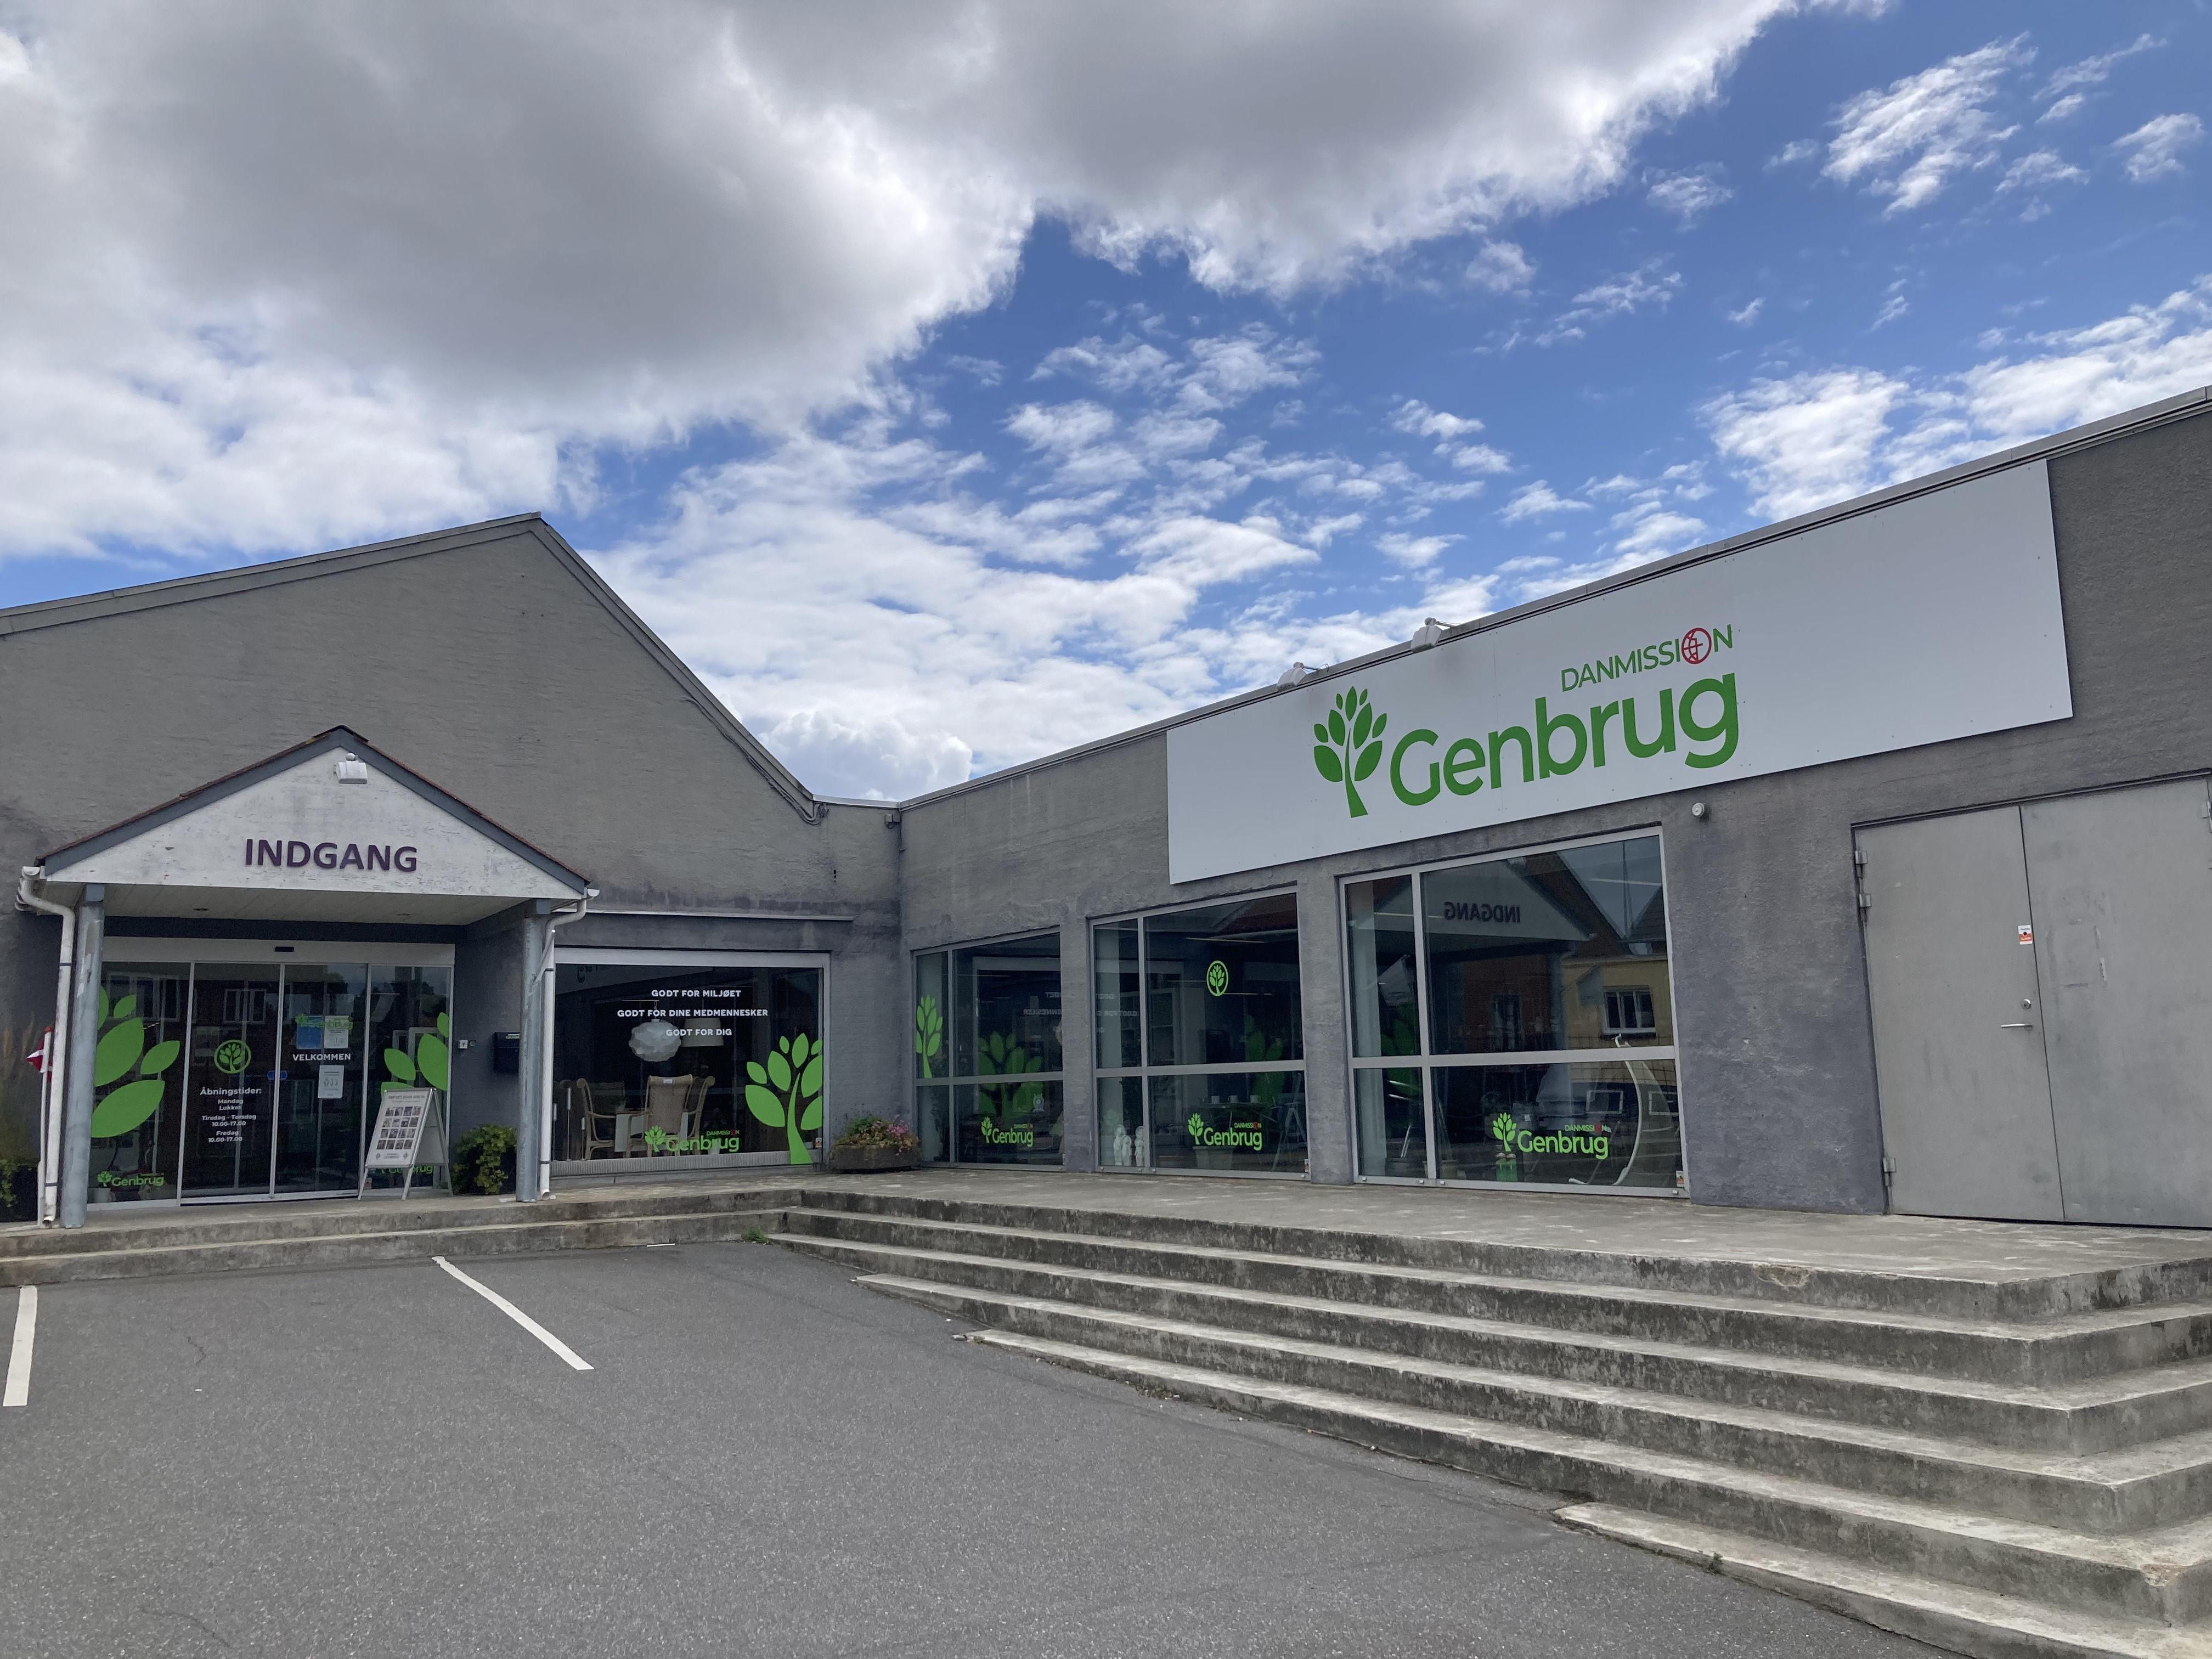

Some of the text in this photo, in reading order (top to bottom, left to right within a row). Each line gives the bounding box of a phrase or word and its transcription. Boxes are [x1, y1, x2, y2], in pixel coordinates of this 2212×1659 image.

[1561, 624, 1734, 692] DANMISSION
[1390, 673, 1739, 806] Genbrug
[245, 839, 417, 872] INDGANG
[200, 1086, 262, 1096] Åbningstider:
[665, 1135, 740, 1152] Genbrug
[992, 1127, 1033, 1147] Genbrug
[1204, 1127, 1262, 1151] Genbrug
[1517, 1130, 1609, 1160] Genbrug
[111, 1176, 164, 1187] Genbrug
